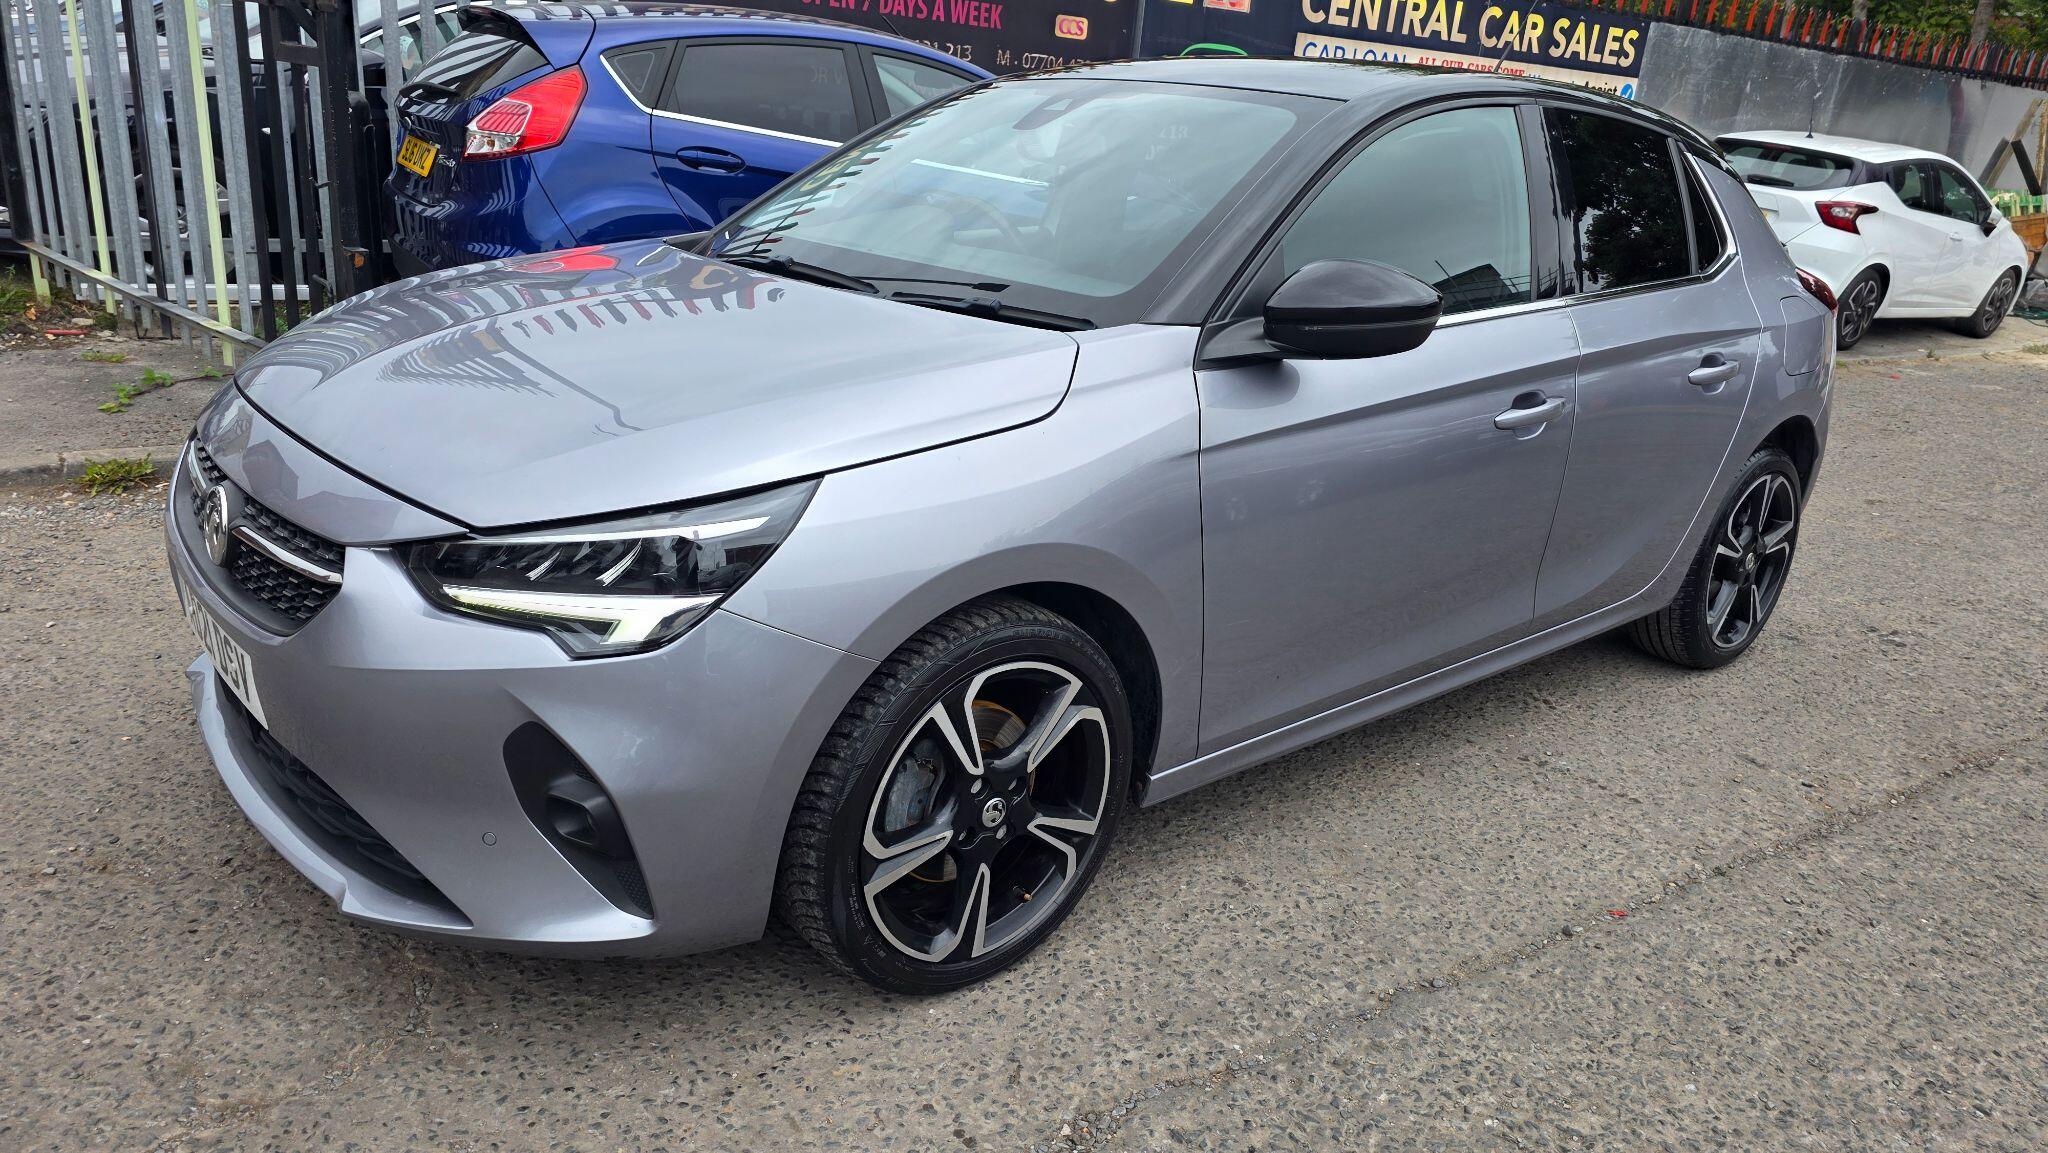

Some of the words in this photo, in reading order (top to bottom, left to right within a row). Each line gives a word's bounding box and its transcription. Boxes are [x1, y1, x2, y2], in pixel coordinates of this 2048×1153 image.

[880, 0, 928, 19] DAYS
[932, 0, 945, 22] A
[951, 0, 1003, 29] WEEK
[1302, 0, 1467, 44] CENTRAL
[1479, 6, 1545, 54] CAR
[1549, 18, 1639, 68] SALES
